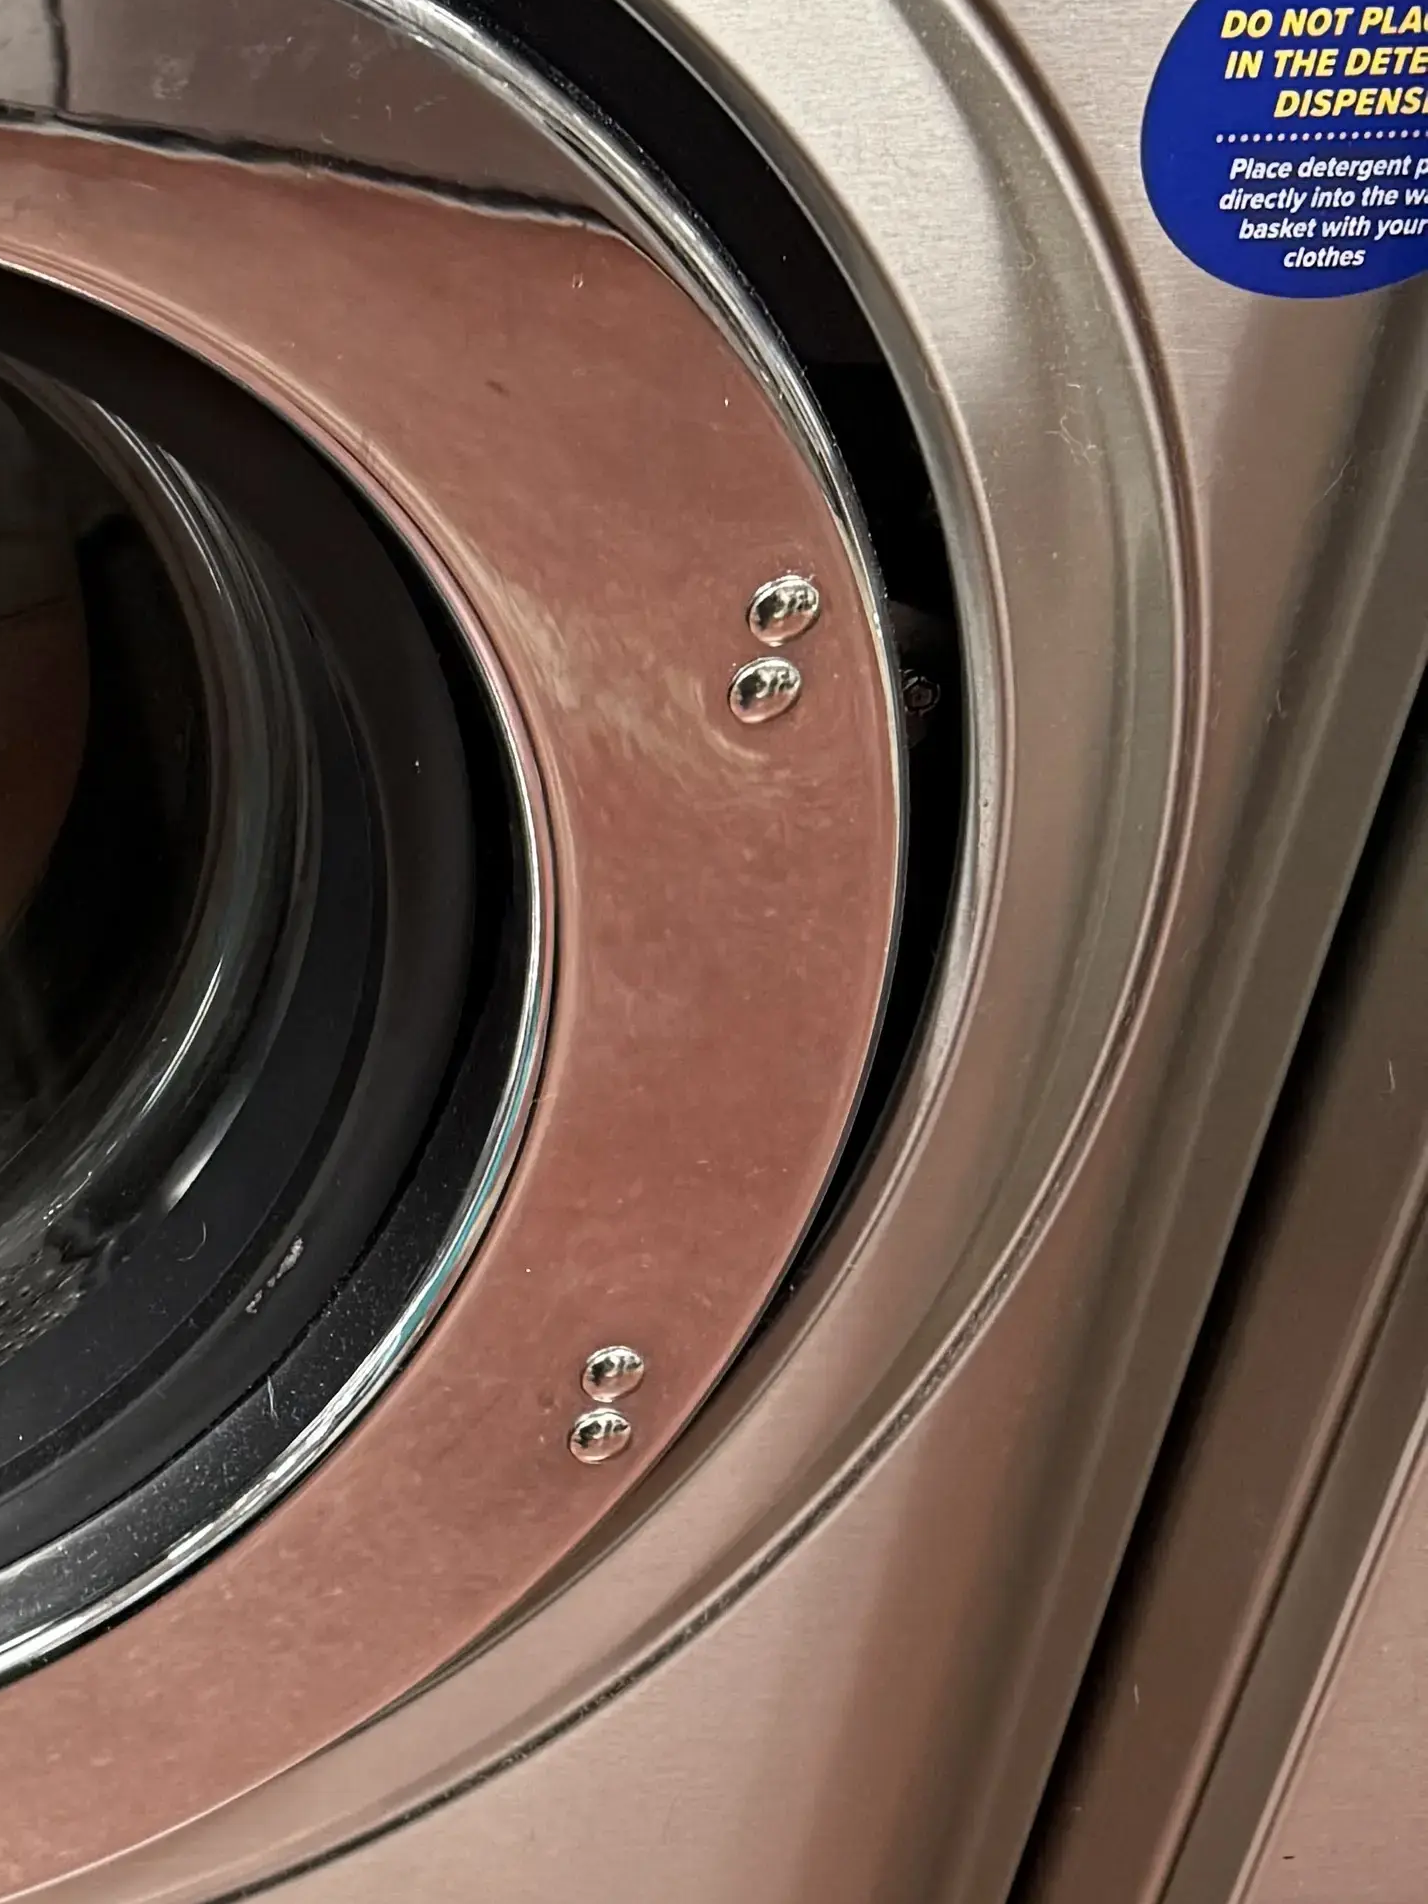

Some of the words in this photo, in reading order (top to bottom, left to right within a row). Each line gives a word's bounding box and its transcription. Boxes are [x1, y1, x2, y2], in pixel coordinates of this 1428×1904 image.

[1221, 9, 1273, 38] DO
[1280, 8, 1354, 36] NOT
[1225, 50, 1263, 79] IN
[1274, 49, 1339, 77] THE
[1230, 158, 1292, 180] Place
[1298, 155, 1412, 181] detergent
